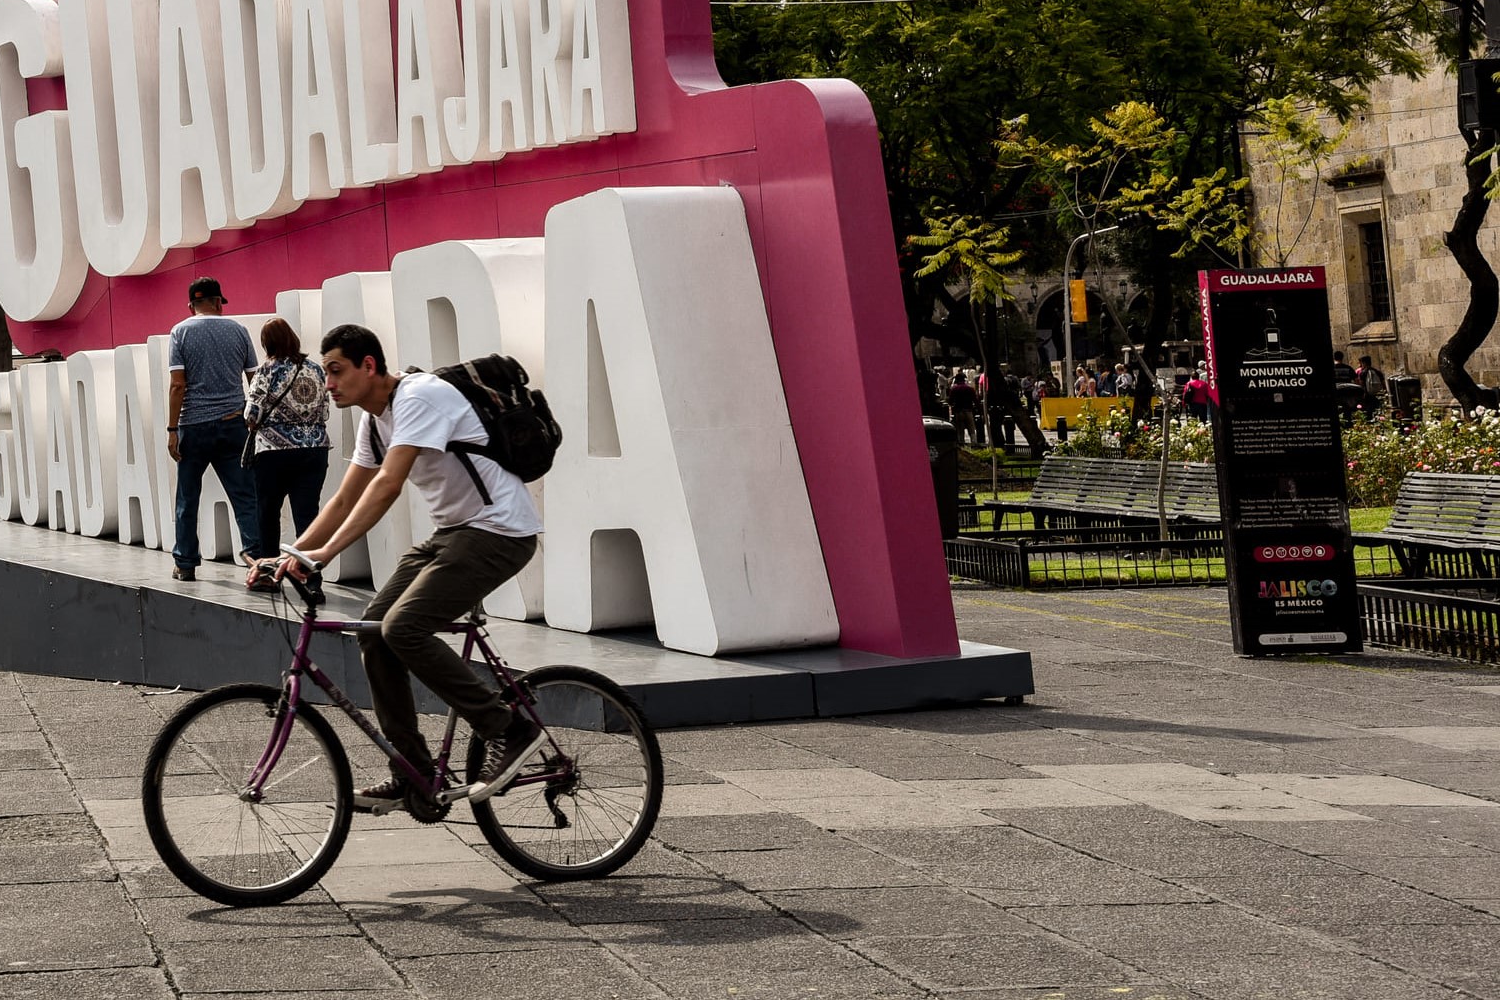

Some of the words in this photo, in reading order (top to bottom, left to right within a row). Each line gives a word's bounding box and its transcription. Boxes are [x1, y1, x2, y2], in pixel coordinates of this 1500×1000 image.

[1220, 272, 1315, 286] GUADALAJARA
[1201, 288, 1216, 390] GUADALAJARA
[1239, 367, 1313, 377] MONUMENTO
[1248, 379, 1256, 388] A
[1258, 377, 1307, 388] HIDALGO
[1258, 579, 1338, 598] JALISCO
